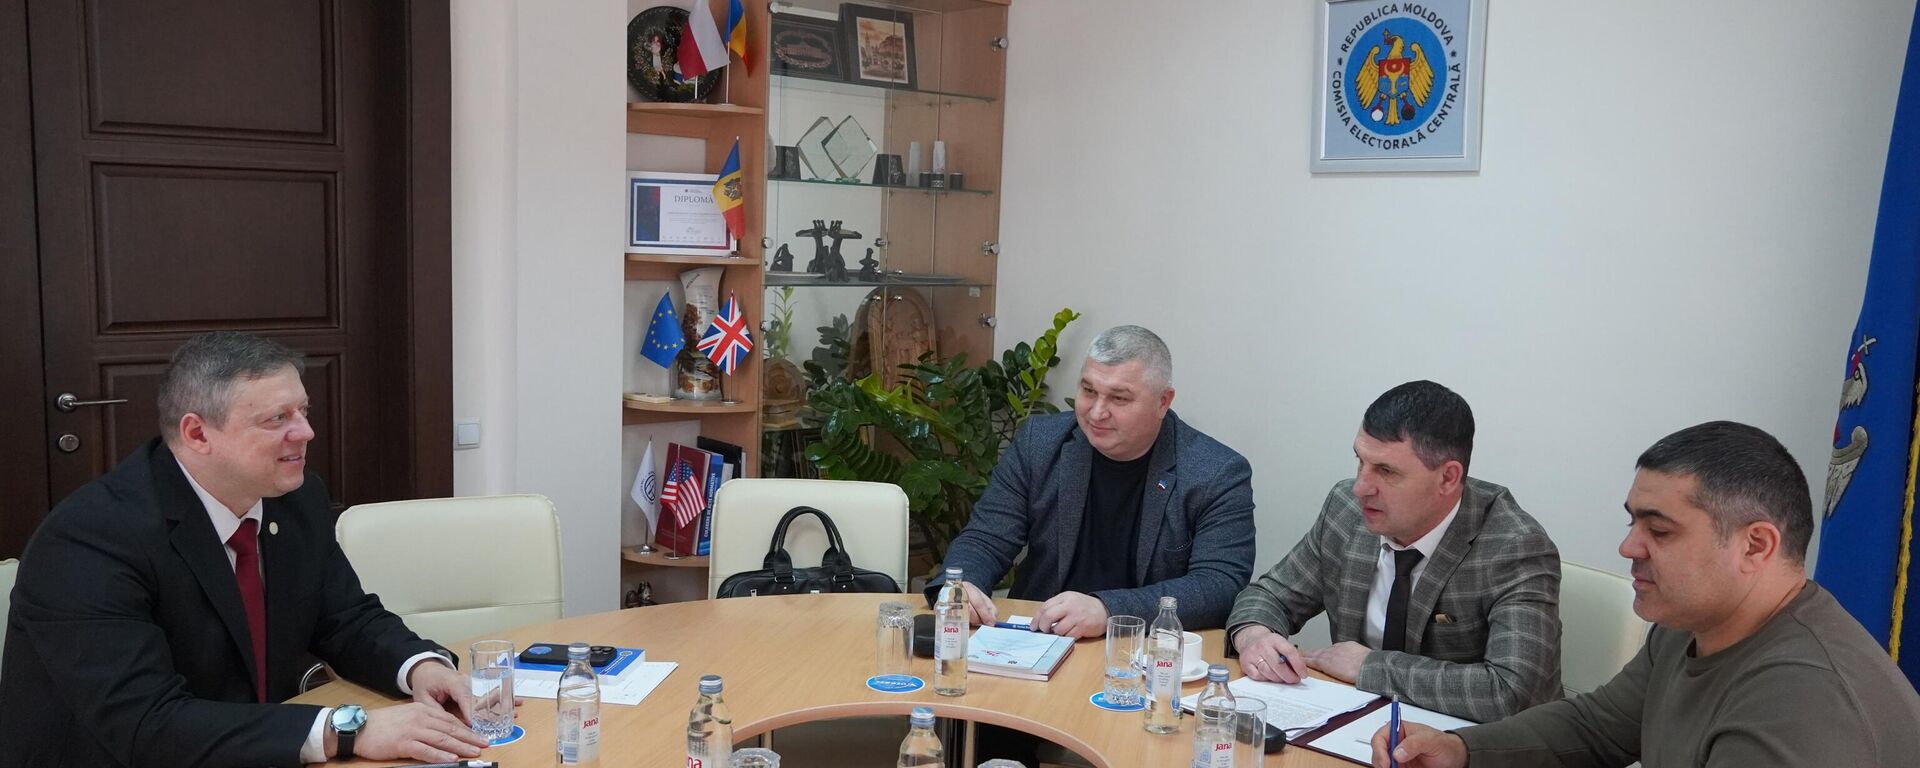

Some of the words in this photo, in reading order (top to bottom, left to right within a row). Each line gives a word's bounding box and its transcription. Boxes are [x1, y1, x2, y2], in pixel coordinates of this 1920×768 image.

[1341, 3, 1399, 53] REPUBLICA
[1402, 3, 1455, 46] MOLDOVA
[1332, 70, 1352, 127] COMISIA
[1349, 124, 1426, 150] ELECTORALĂ
[1426, 63, 1461, 134] CENTRALĂ
[1156, 660, 1173, 668] Jana
[583, 717, 599, 729] Jana
[1215, 742, 1232, 751] Jana
